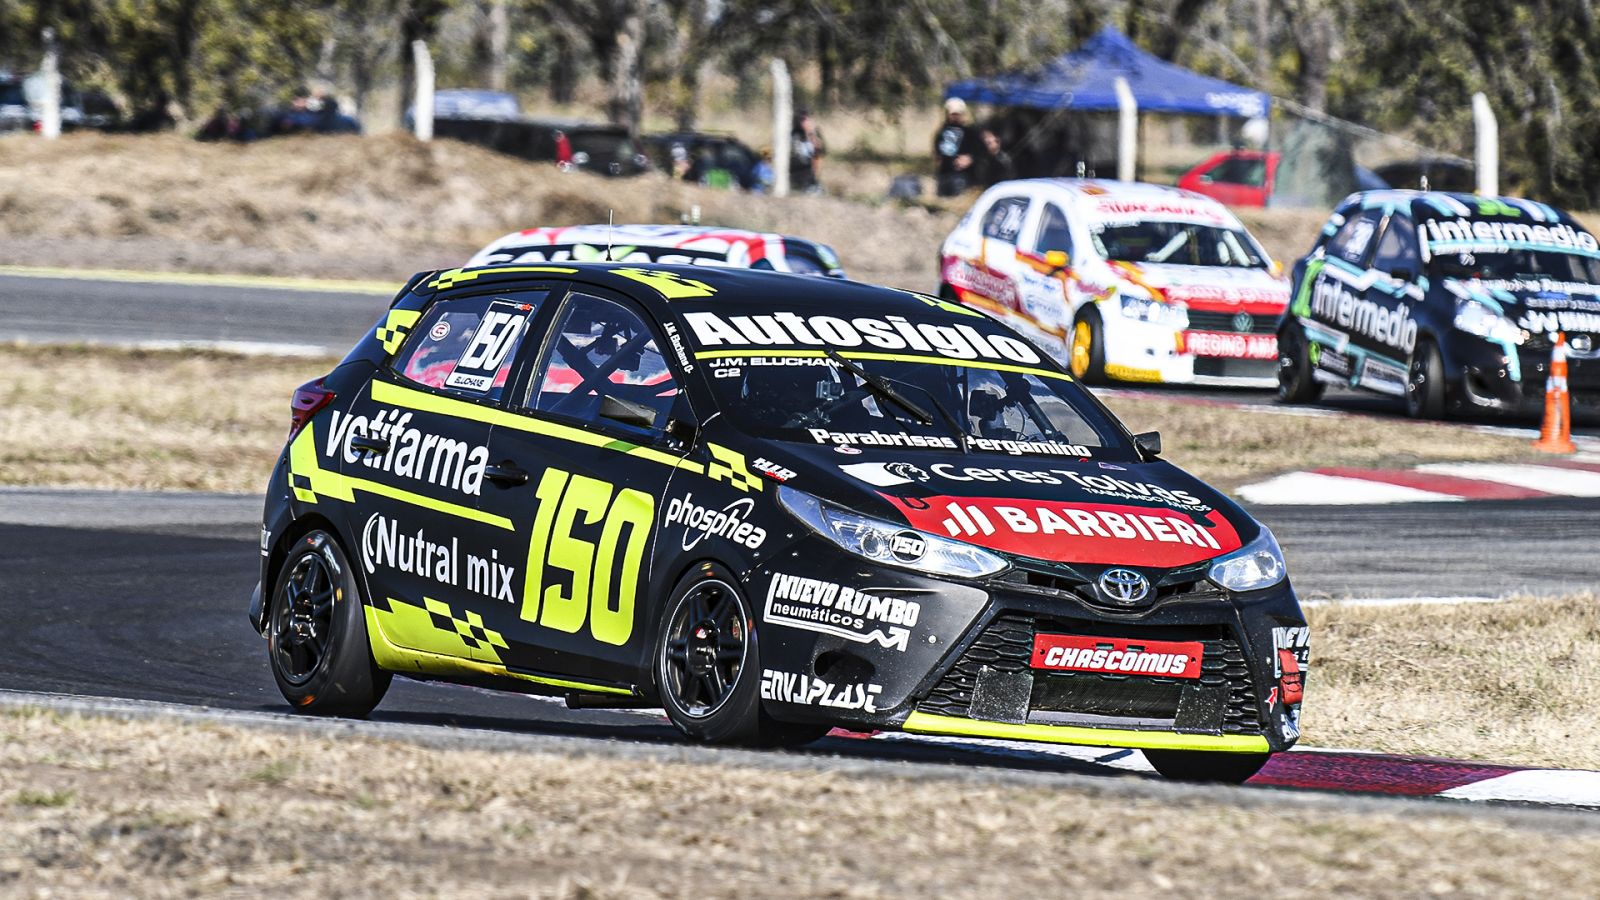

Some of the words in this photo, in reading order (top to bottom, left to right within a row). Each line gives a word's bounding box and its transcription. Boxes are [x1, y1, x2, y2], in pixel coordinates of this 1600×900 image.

[1427, 217, 1599, 251] intermedio
[459, 311, 525, 370] 150
[683, 312, 1040, 364] Autosiglo
[709, 358, 747, 367] J.M.
[751, 357, 850, 368] ELUCHAN
[714, 368, 741, 378] C2
[808, 428, 957, 449] Parabrisas
[665, 493, 766, 550] phosphea
[994, 506, 1222, 549] BARBIERI
[375, 515, 458, 586] Nutral
[467, 549, 515, 604] mix
[520, 467, 654, 646] 150
[892, 535, 926, 556] 150
[772, 602, 864, 629] neumáticos
[775, 574, 840, 605] NUEVO
[834, 586, 921, 627] RUMBO
[1044, 646, 1189, 674] CHASCOMUS
